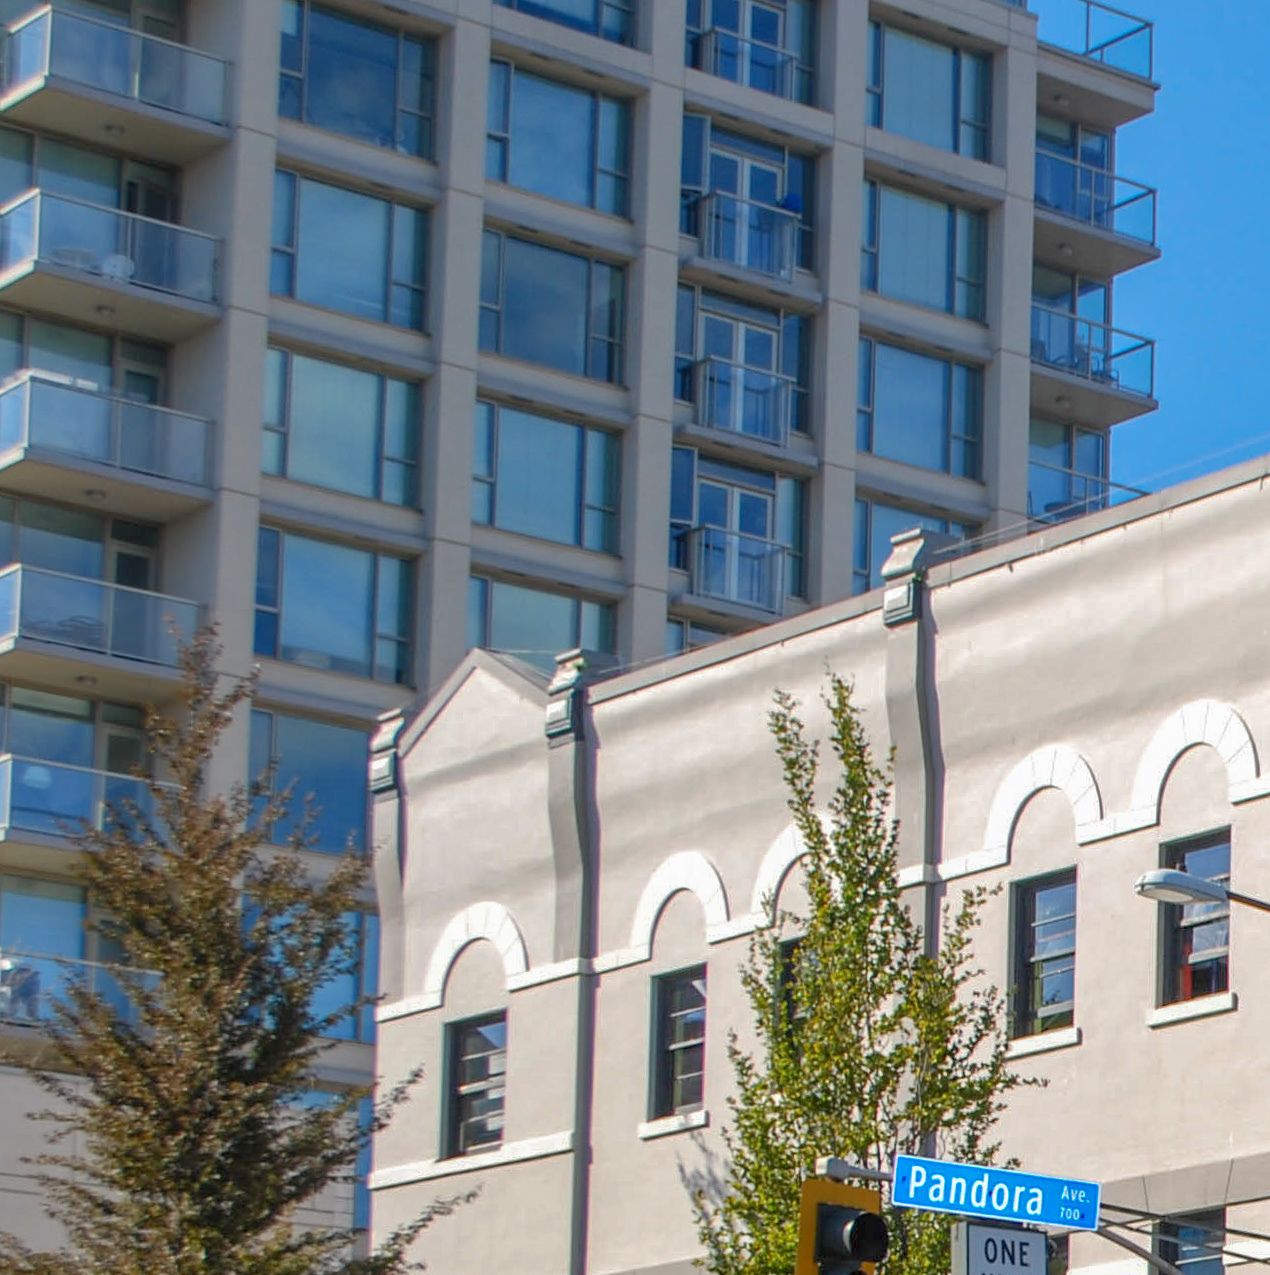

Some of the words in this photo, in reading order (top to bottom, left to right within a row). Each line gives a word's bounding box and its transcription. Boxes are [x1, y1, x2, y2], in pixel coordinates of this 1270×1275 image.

[908, 1165, 1044, 1216] Pandora
[1060, 1184, 1091, 1205] Ave.
[1059, 1206, 1081, 1221] 700
[984, 1237, 1030, 1267] ONE
